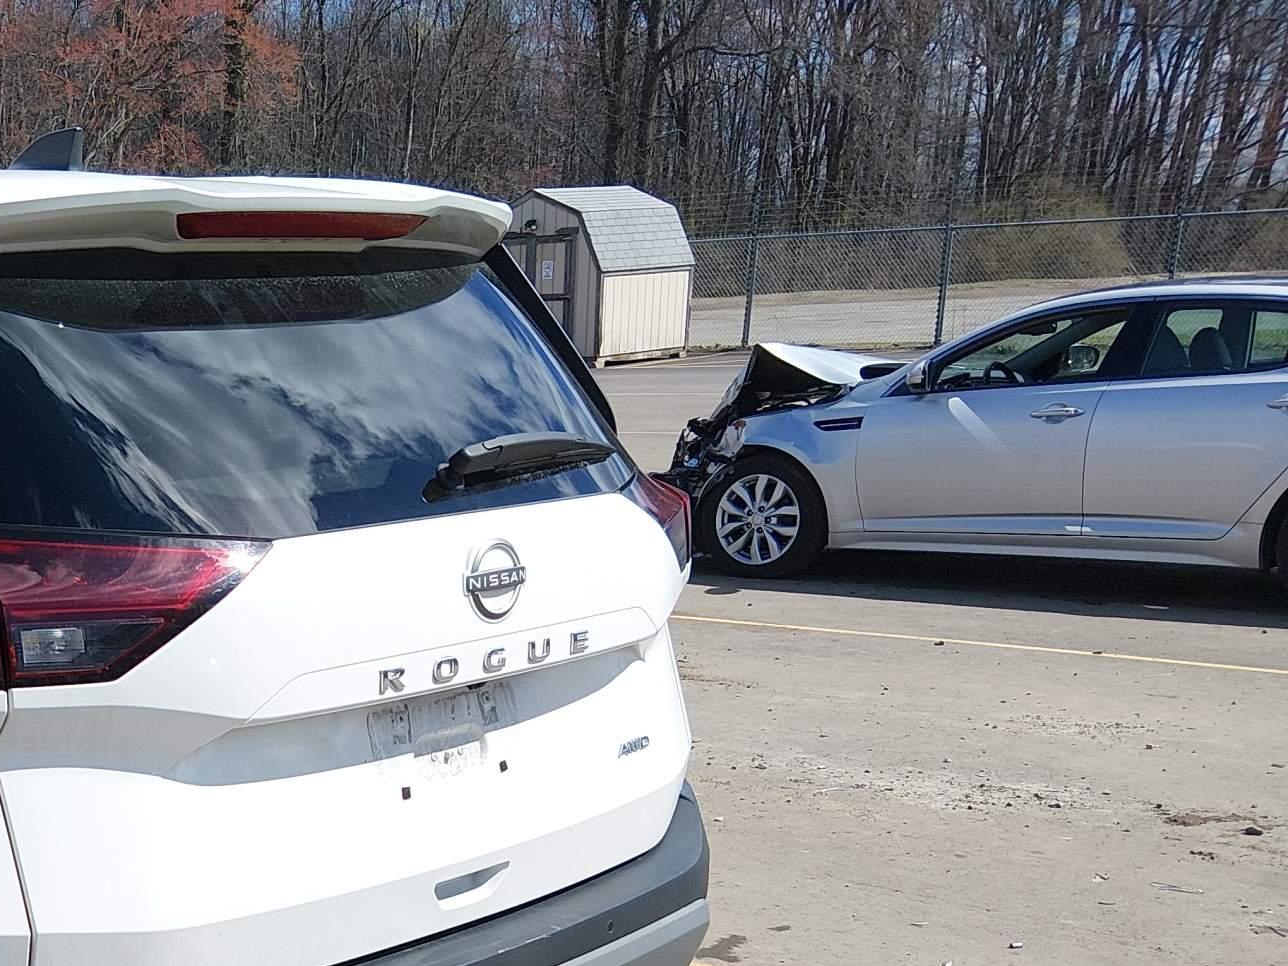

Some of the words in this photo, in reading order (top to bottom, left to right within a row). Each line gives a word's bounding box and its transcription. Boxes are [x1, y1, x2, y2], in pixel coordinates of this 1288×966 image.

[469, 568, 526, 590] NISSAN
[378, 630, 589, 696] ROGUE
[617, 735, 650, 760] AWD
